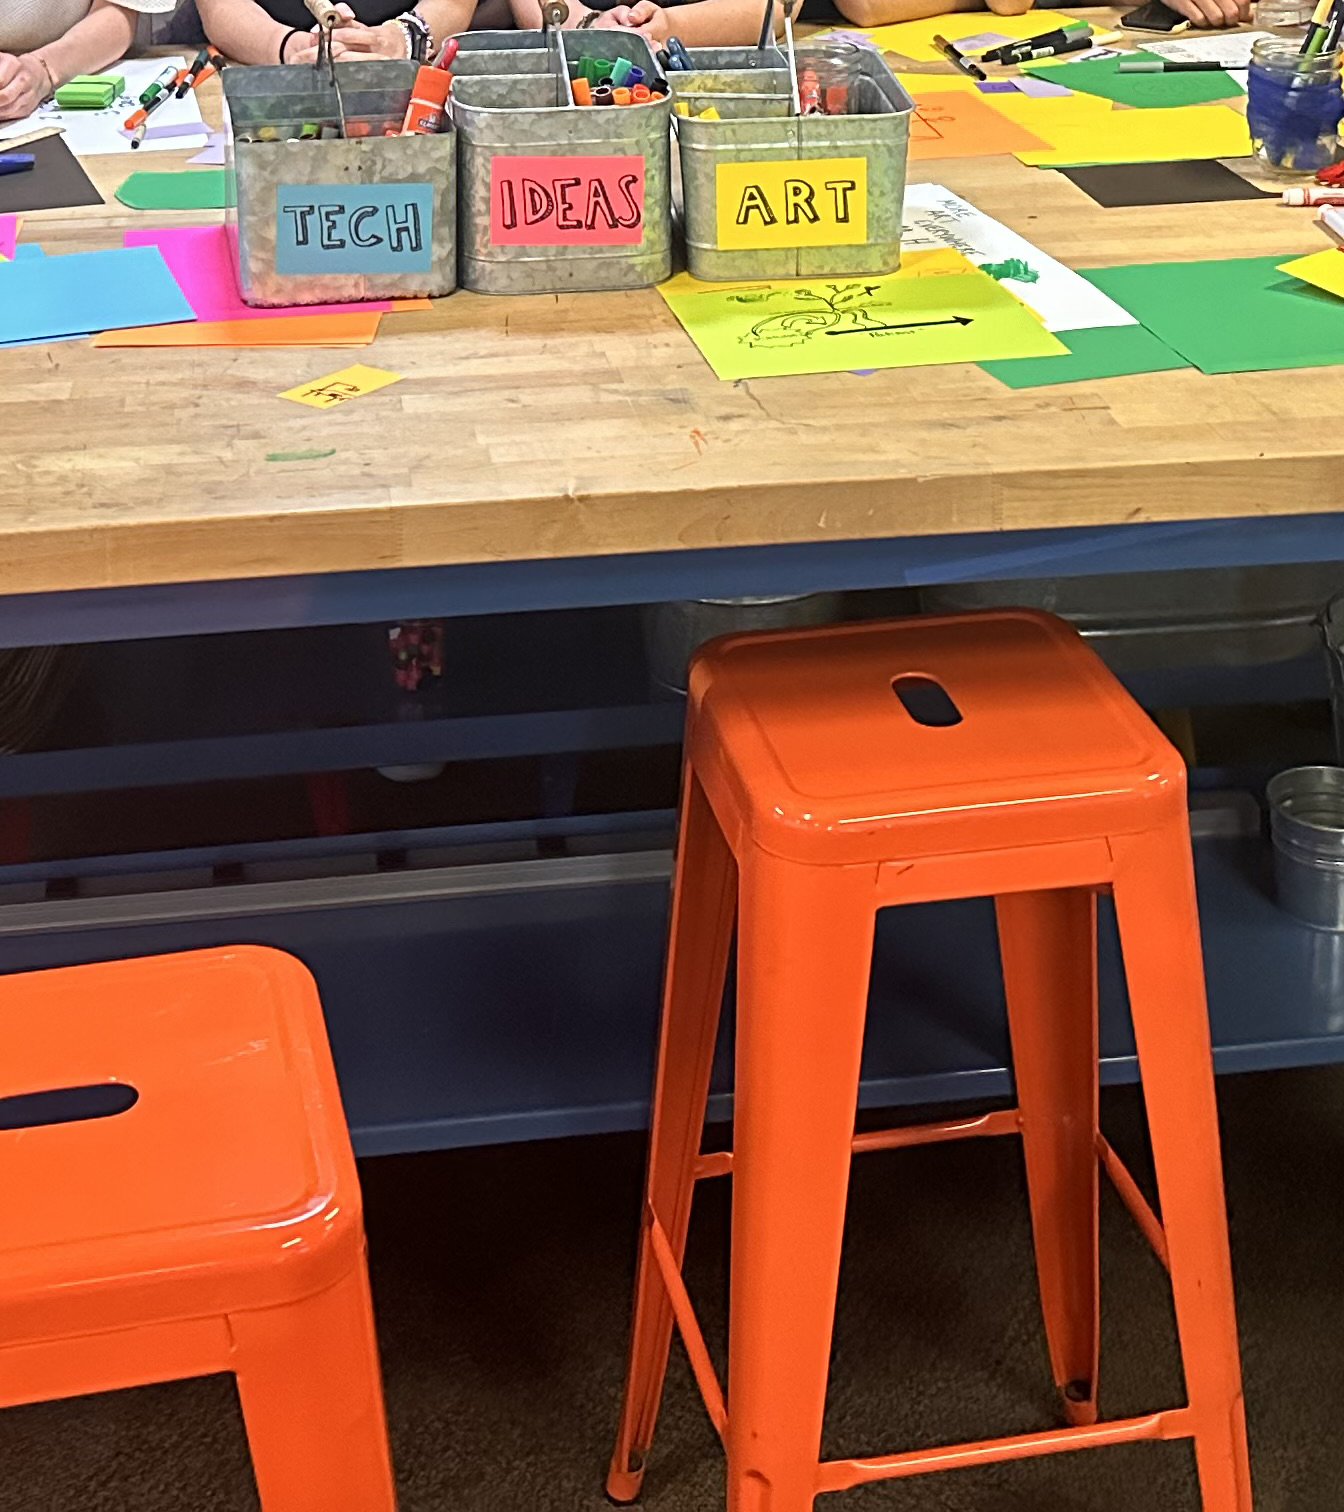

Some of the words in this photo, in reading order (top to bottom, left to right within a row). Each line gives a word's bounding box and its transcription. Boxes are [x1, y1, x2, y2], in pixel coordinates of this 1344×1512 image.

[284, 202, 424, 253] TECH
[499, 174, 642, 232] IDEAS
[736, 179, 857, 226] ART
